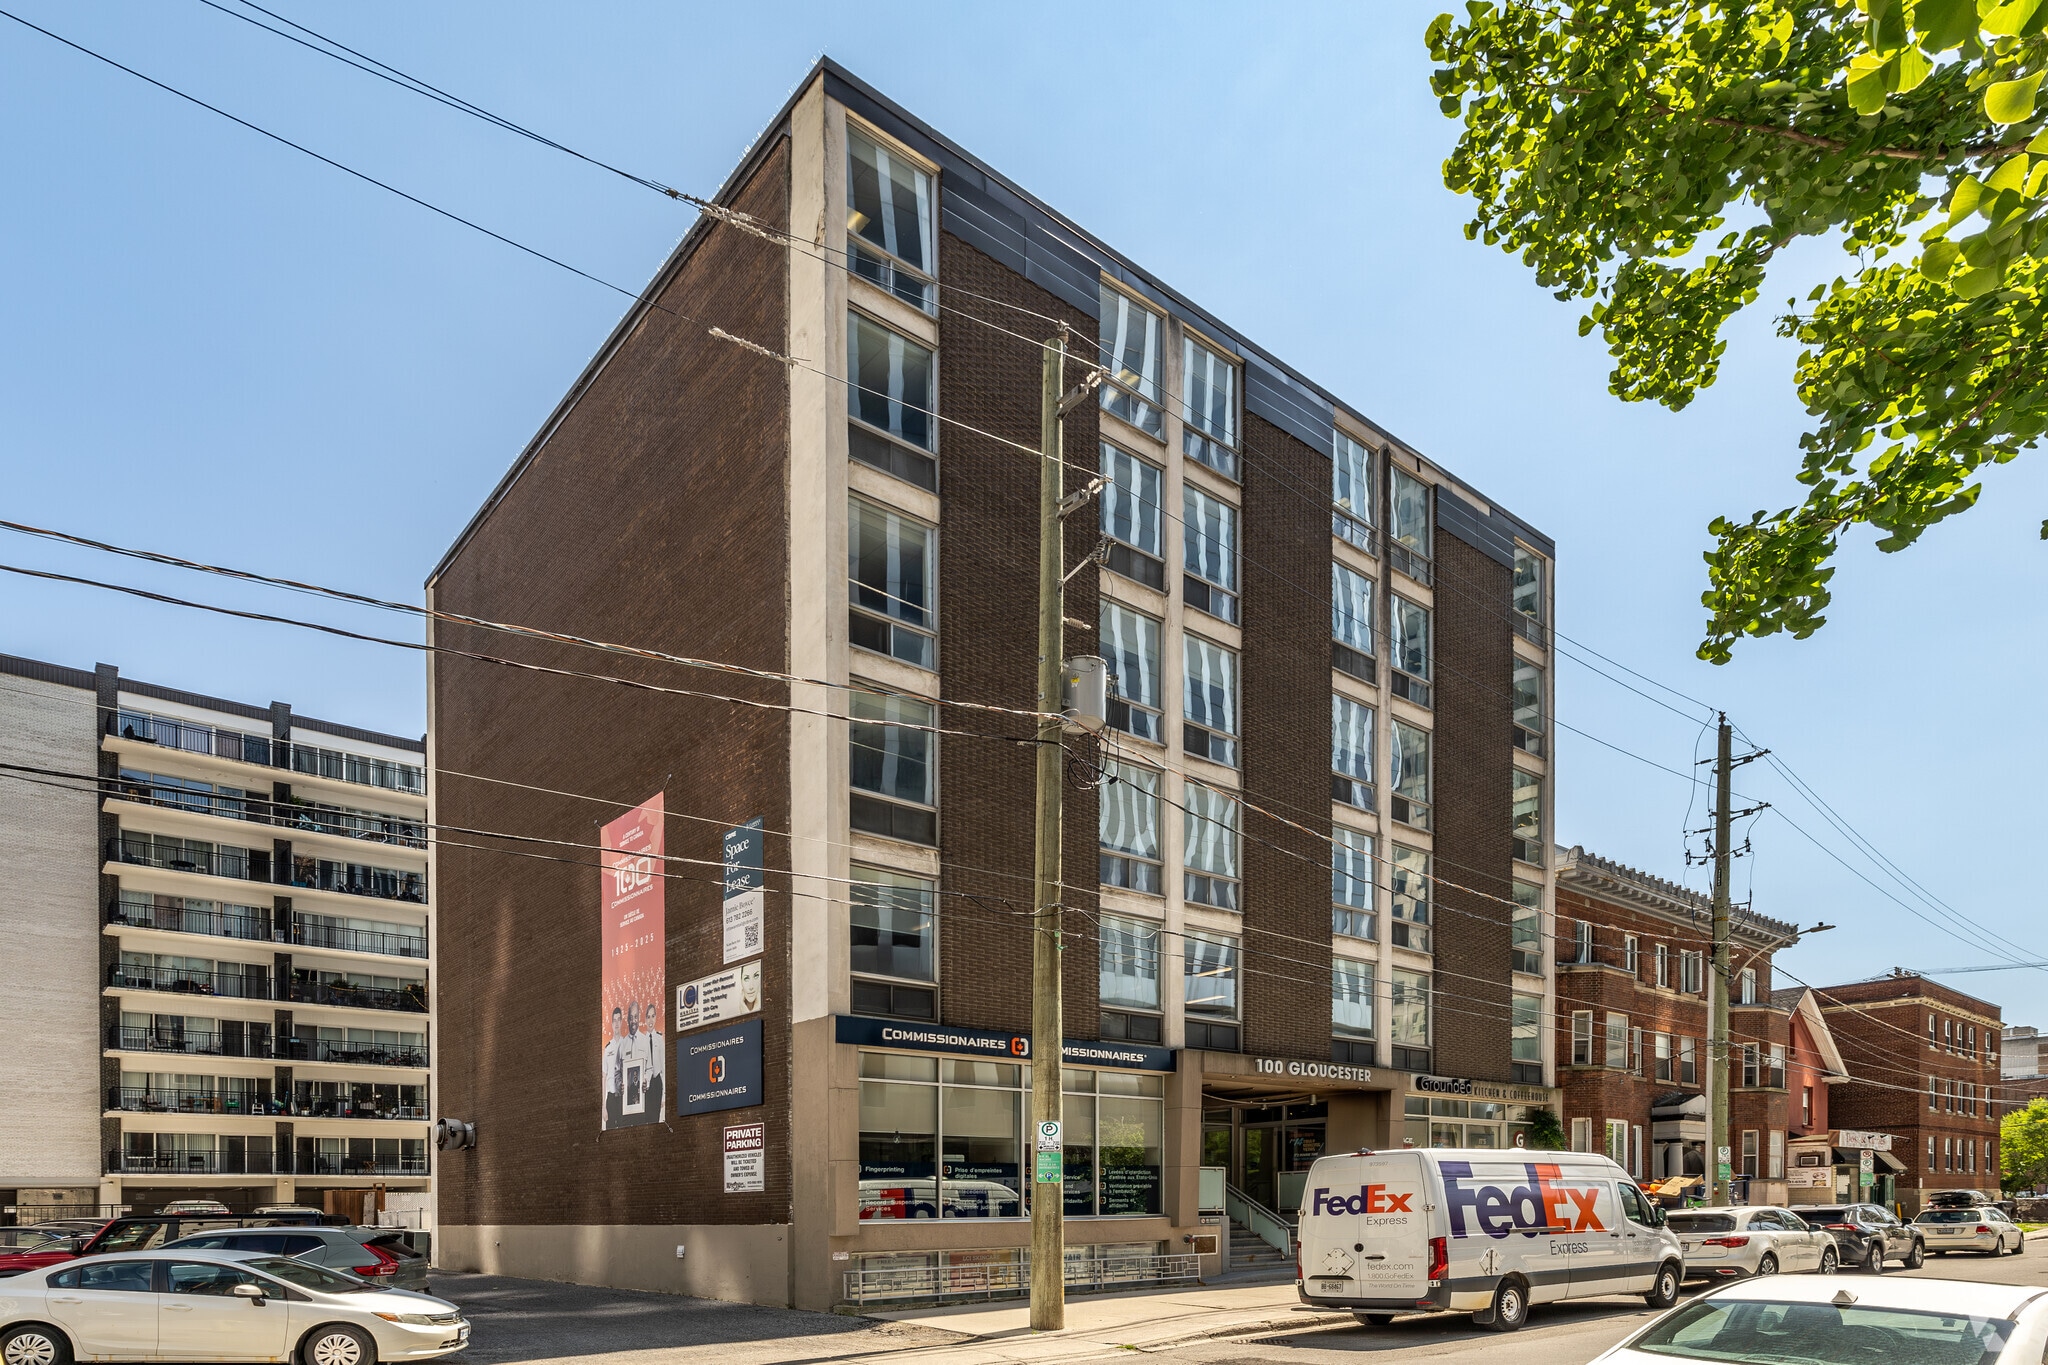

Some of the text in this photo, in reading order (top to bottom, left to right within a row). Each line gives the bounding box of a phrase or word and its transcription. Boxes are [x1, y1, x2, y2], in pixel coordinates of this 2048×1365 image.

[726, 839, 750, 860] Space
[726, 860, 740, 876] For
[726, 874, 750, 893] Lease
[680, 985, 698, 1010] LCI
[690, 1036, 744, 1055] COMMISSIONAIRES
[1256, 1058, 1372, 1082] 100 GLOUCESTER
[688, 1086, 746, 1102] COMMISSIONNAIRES
[1420, 1076, 1549, 1102] Grounded KITCHEN & COFFEEHOUSE
[726, 1128, 762, 1140] PRIVATE
[1516, 1134, 1524, 1148] G
[726, 1138, 762, 1150] PARKING
[1313, 1184, 1414, 1216] FedEx
[1438, 1161, 1607, 1239] FedEx
[1366, 1216, 1408, 1227] Express
[1550, 1239, 1588, 1258] Express
